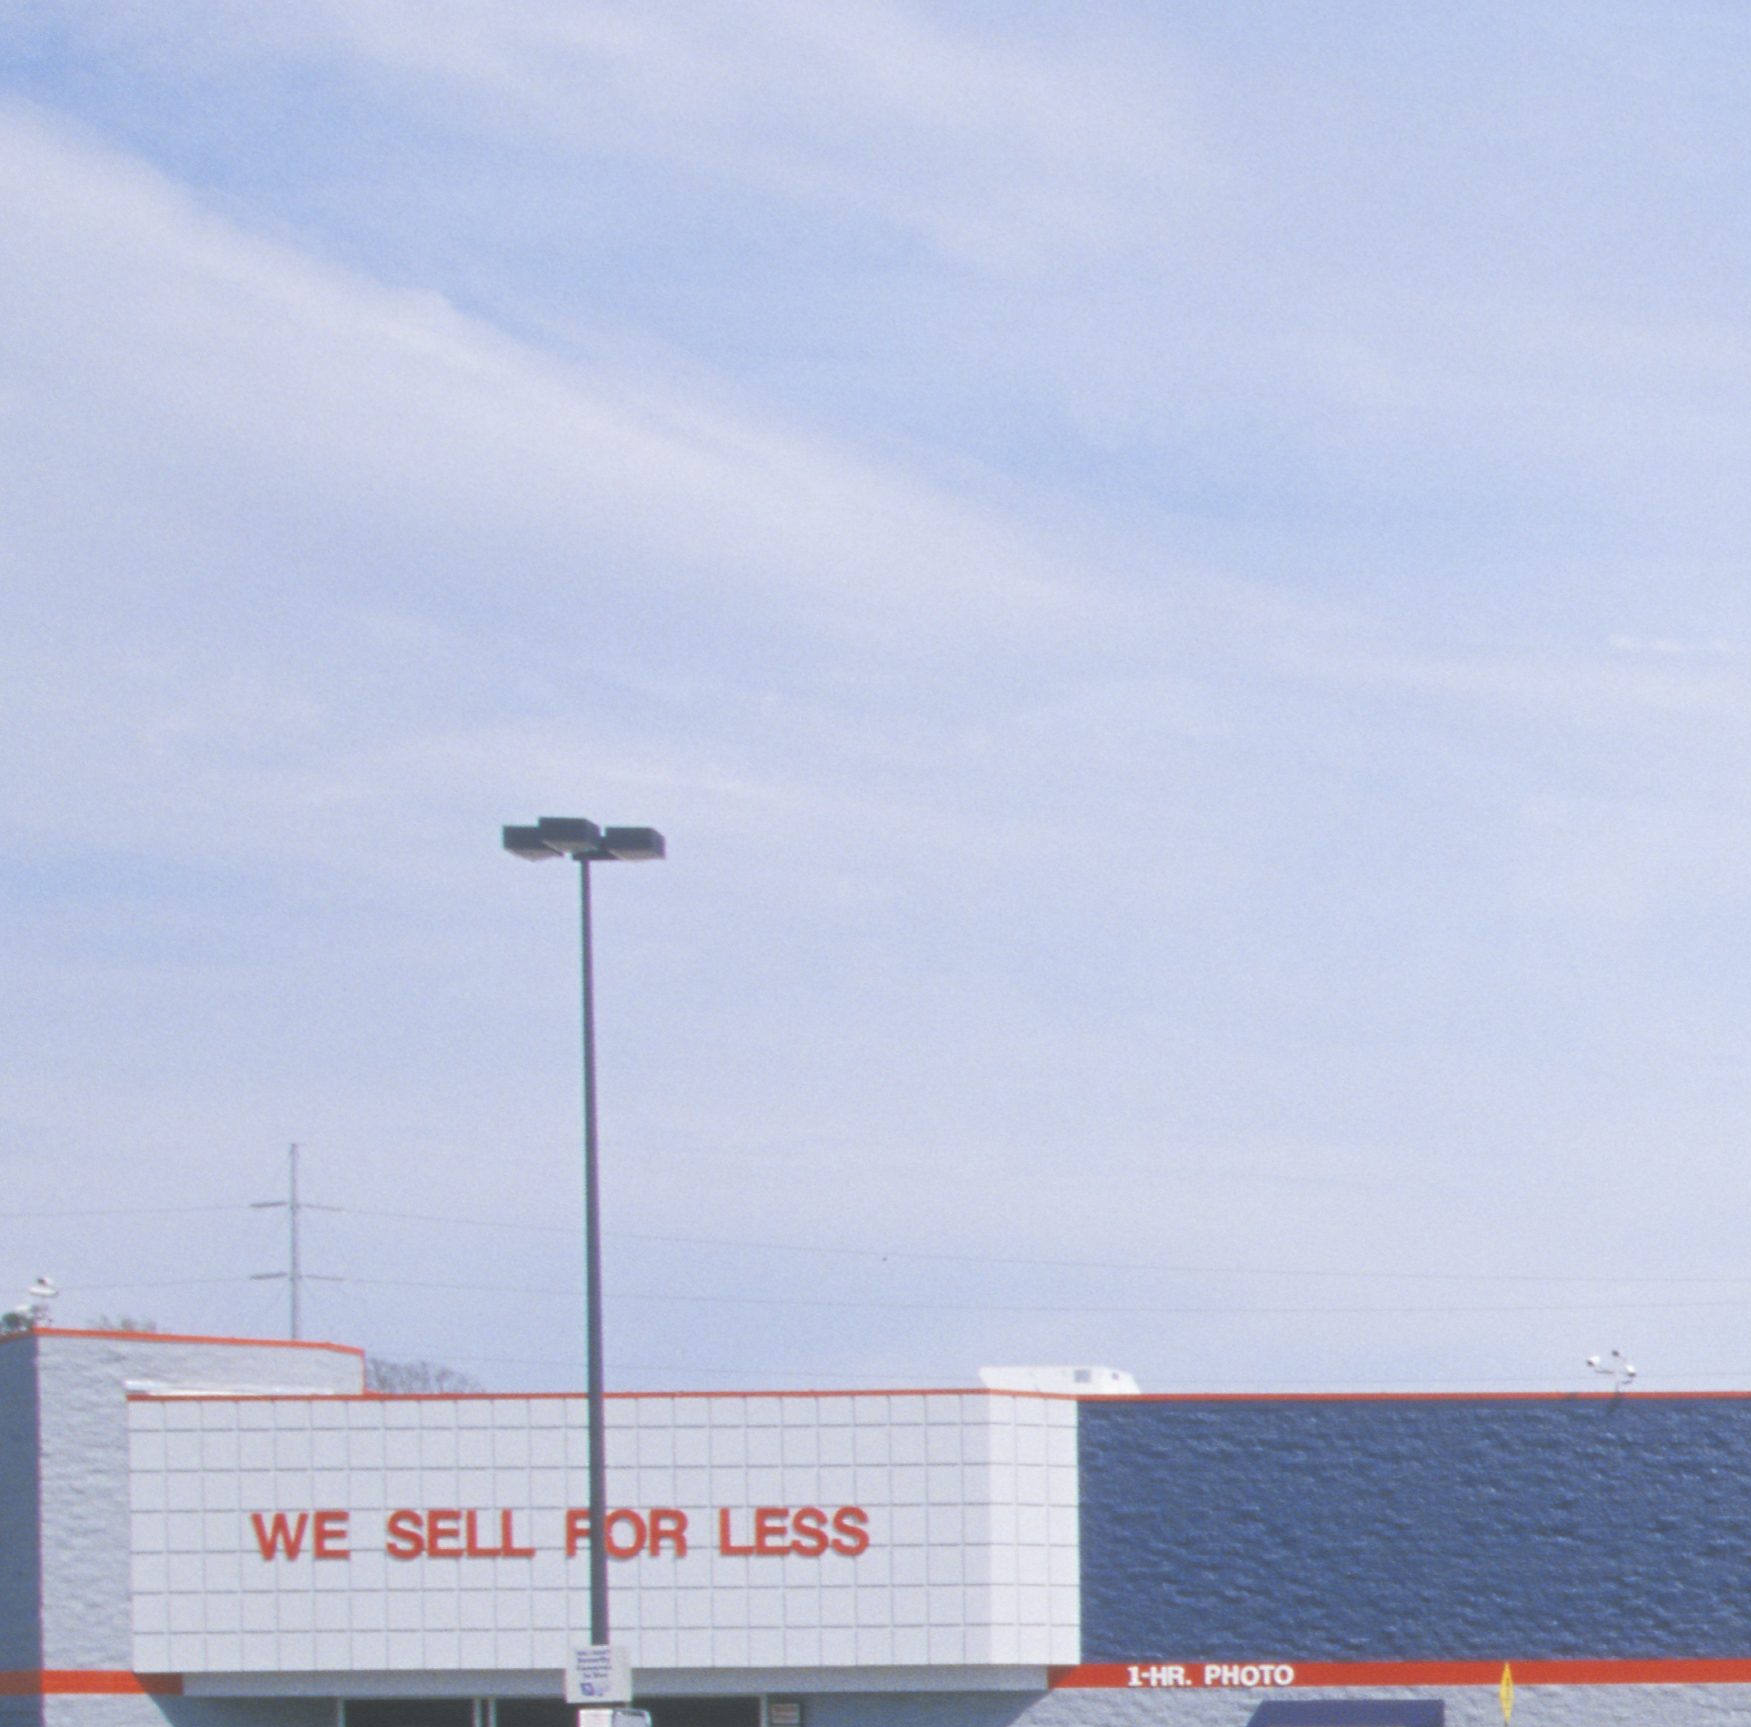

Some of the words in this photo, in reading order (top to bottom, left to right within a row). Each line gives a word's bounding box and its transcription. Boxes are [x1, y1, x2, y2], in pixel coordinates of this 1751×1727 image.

[251, 1510, 350, 1560] WE
[386, 1508, 536, 1560] SELL
[565, 1507, 689, 1560] FOR
[719, 1505, 870, 1558] LESS
[1127, 1666, 1193, 1687] 1-HR.
[1204, 1664, 1295, 1687] PHOTO
